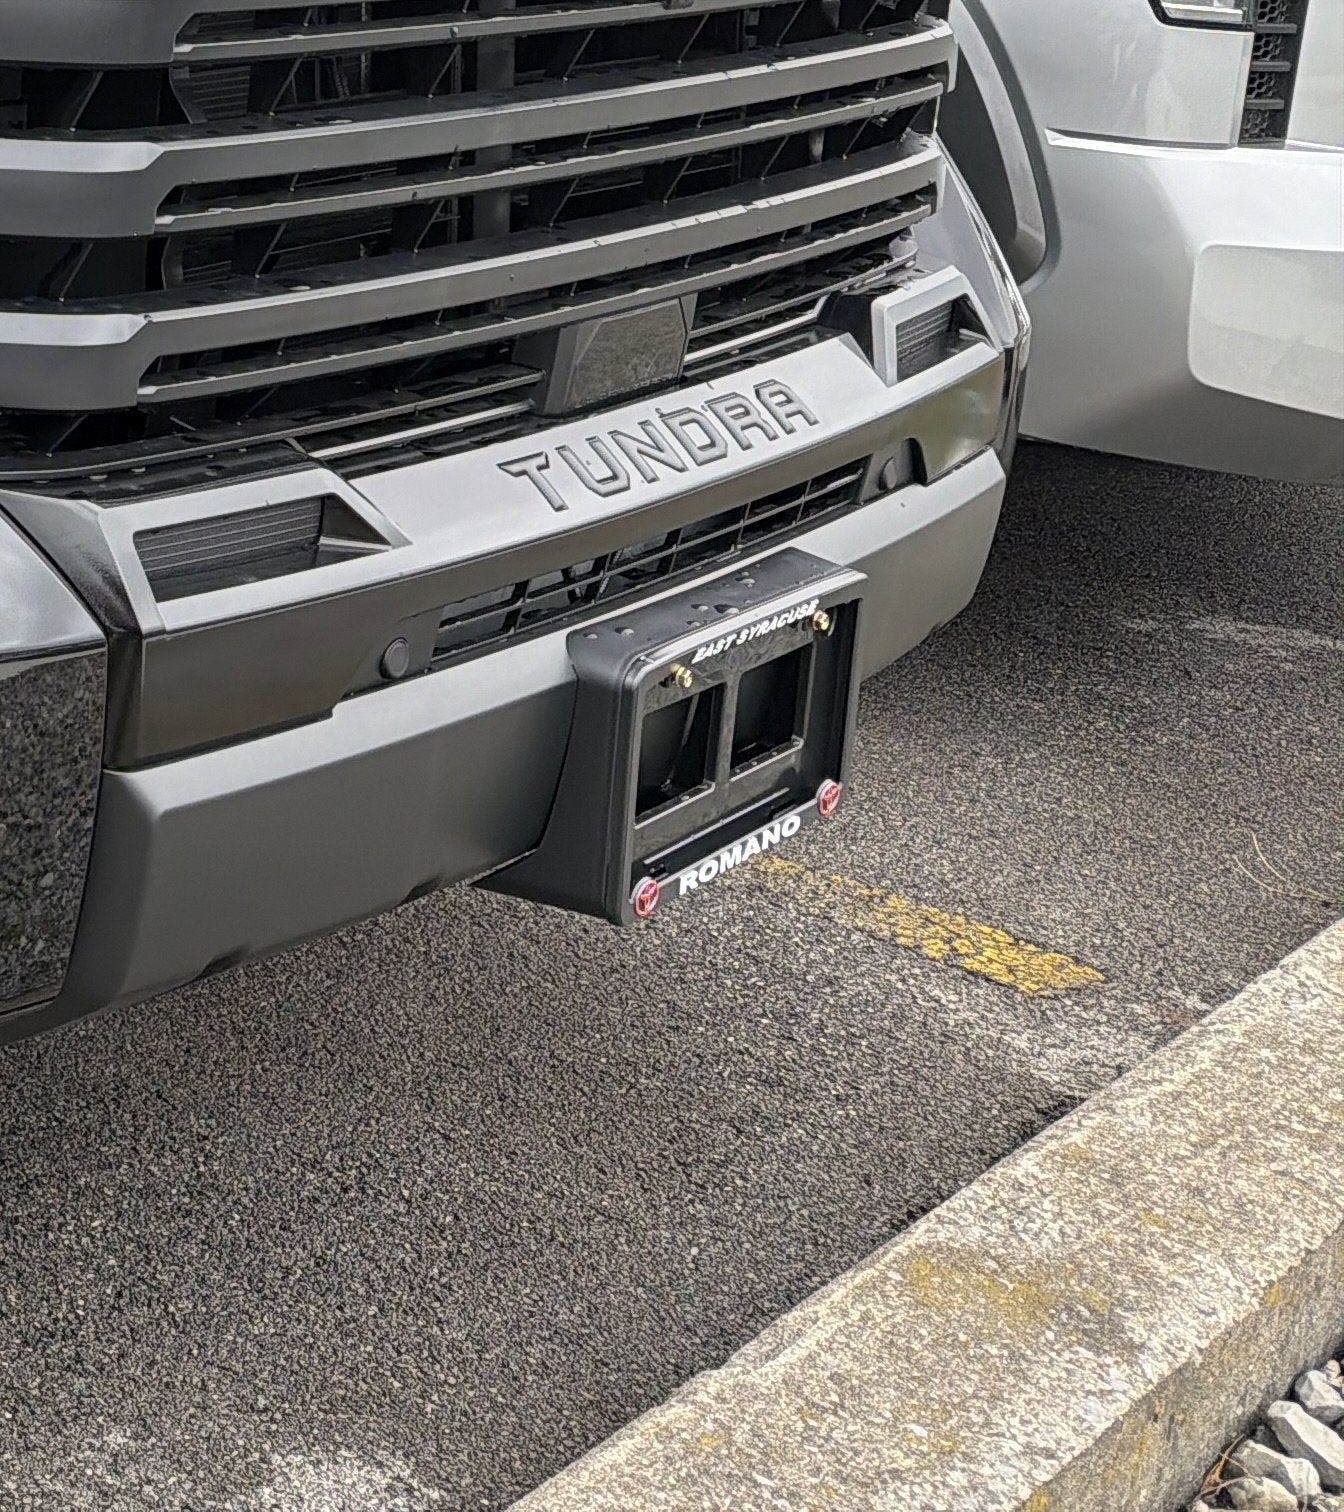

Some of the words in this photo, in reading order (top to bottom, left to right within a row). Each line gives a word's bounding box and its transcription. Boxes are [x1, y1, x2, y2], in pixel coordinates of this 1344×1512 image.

[496, 378, 819, 512] TUNDRA
[691, 633, 738, 665] EAST
[736, 598, 820, 646] SYRACUSE
[679, 815, 801, 895] ROMANO
